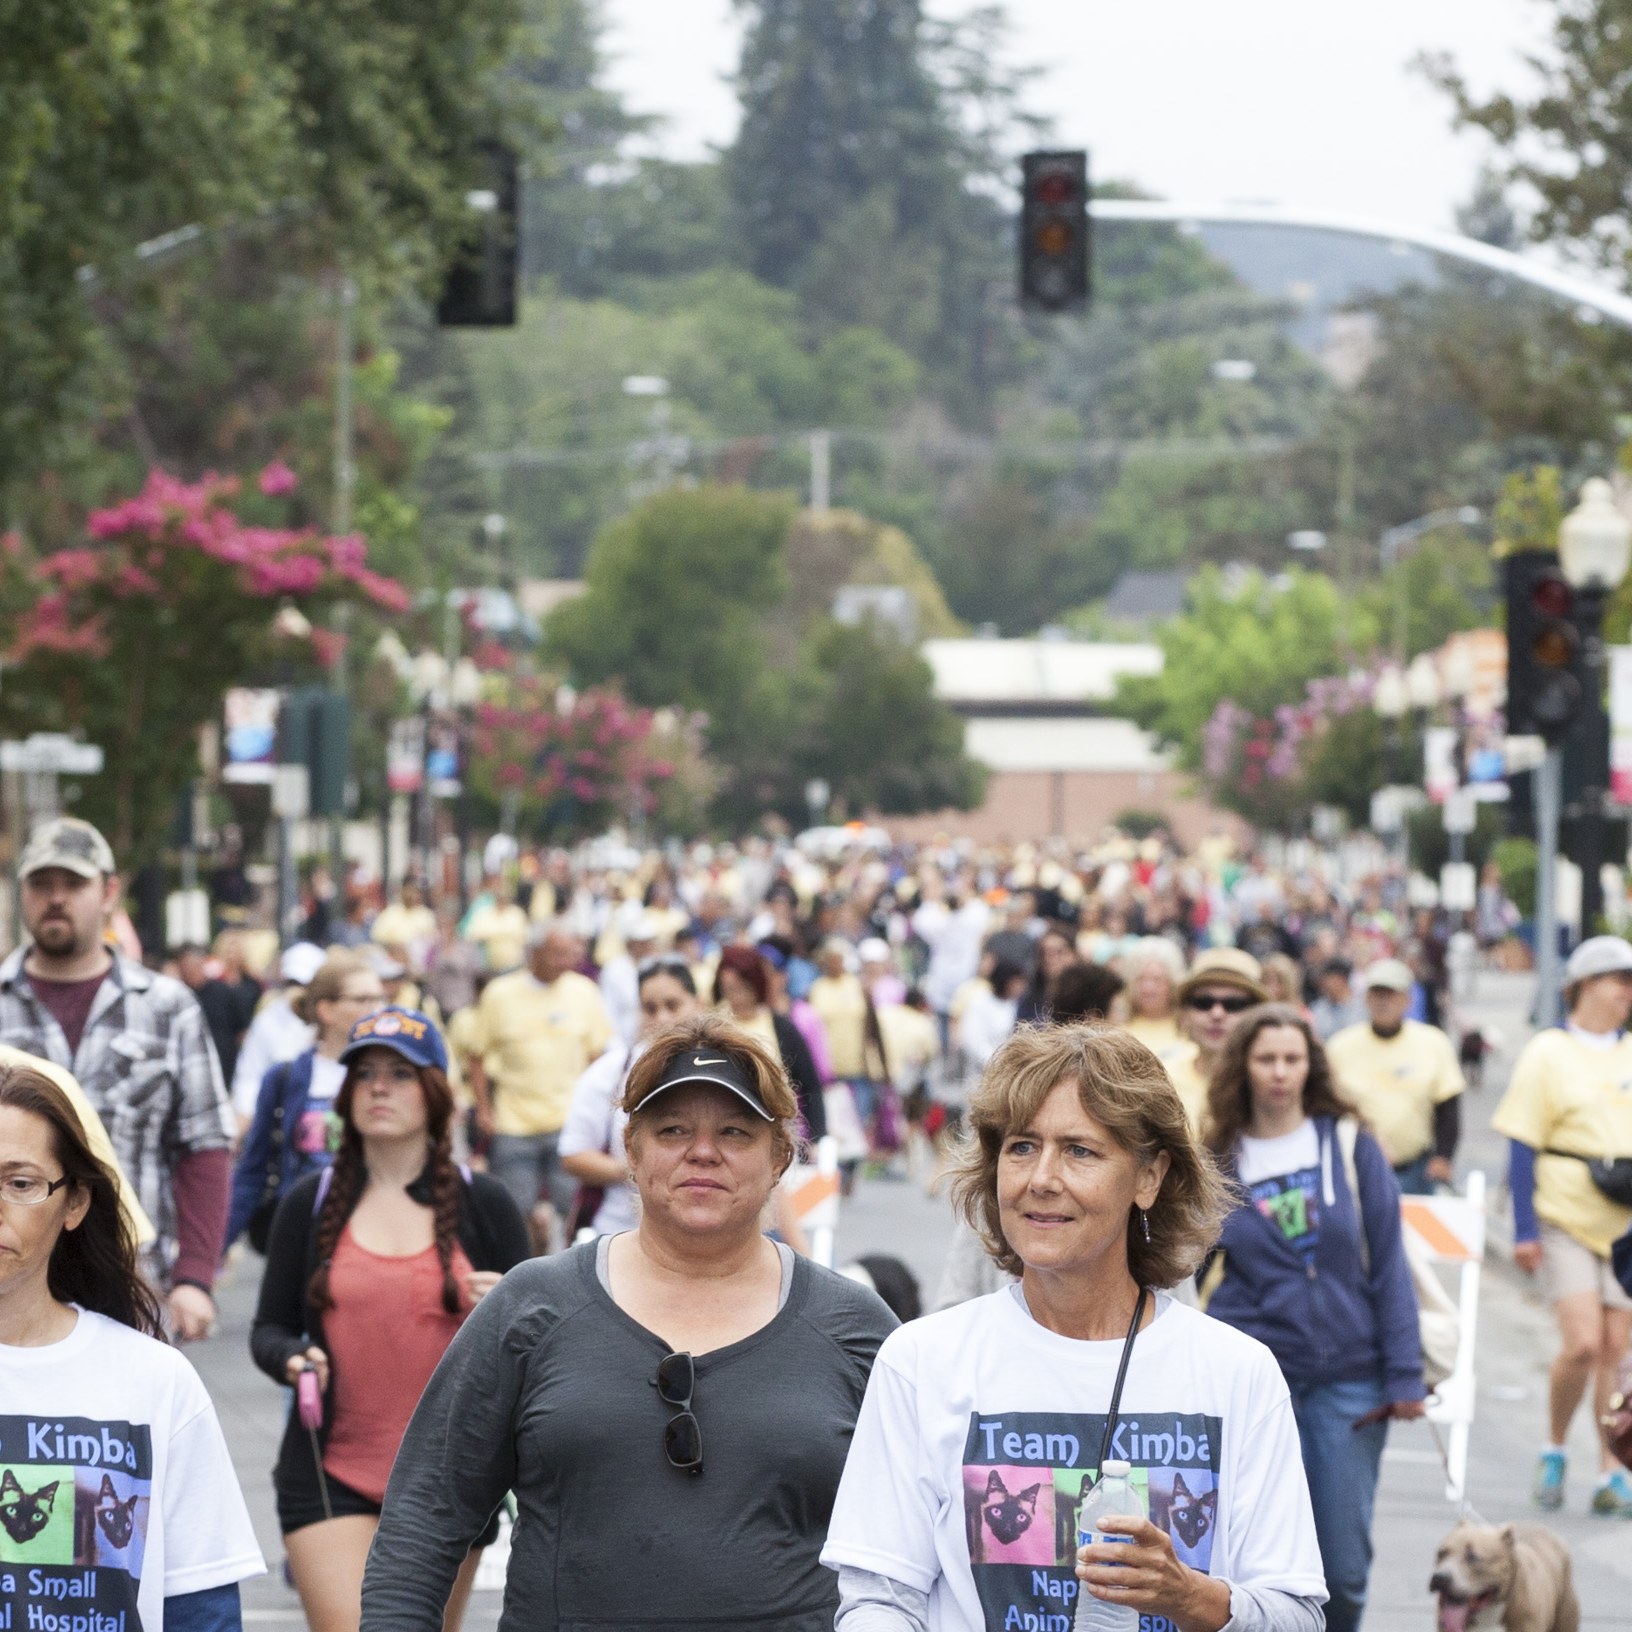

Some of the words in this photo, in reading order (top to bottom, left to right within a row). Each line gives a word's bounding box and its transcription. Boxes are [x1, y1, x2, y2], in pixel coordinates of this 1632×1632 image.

[27, 1422, 138, 1468] Kimba
[978, 1421, 1081, 1469] Team
[28, 1569, 97, 1602] Small
[1031, 1569, 1078, 1607] Nap
